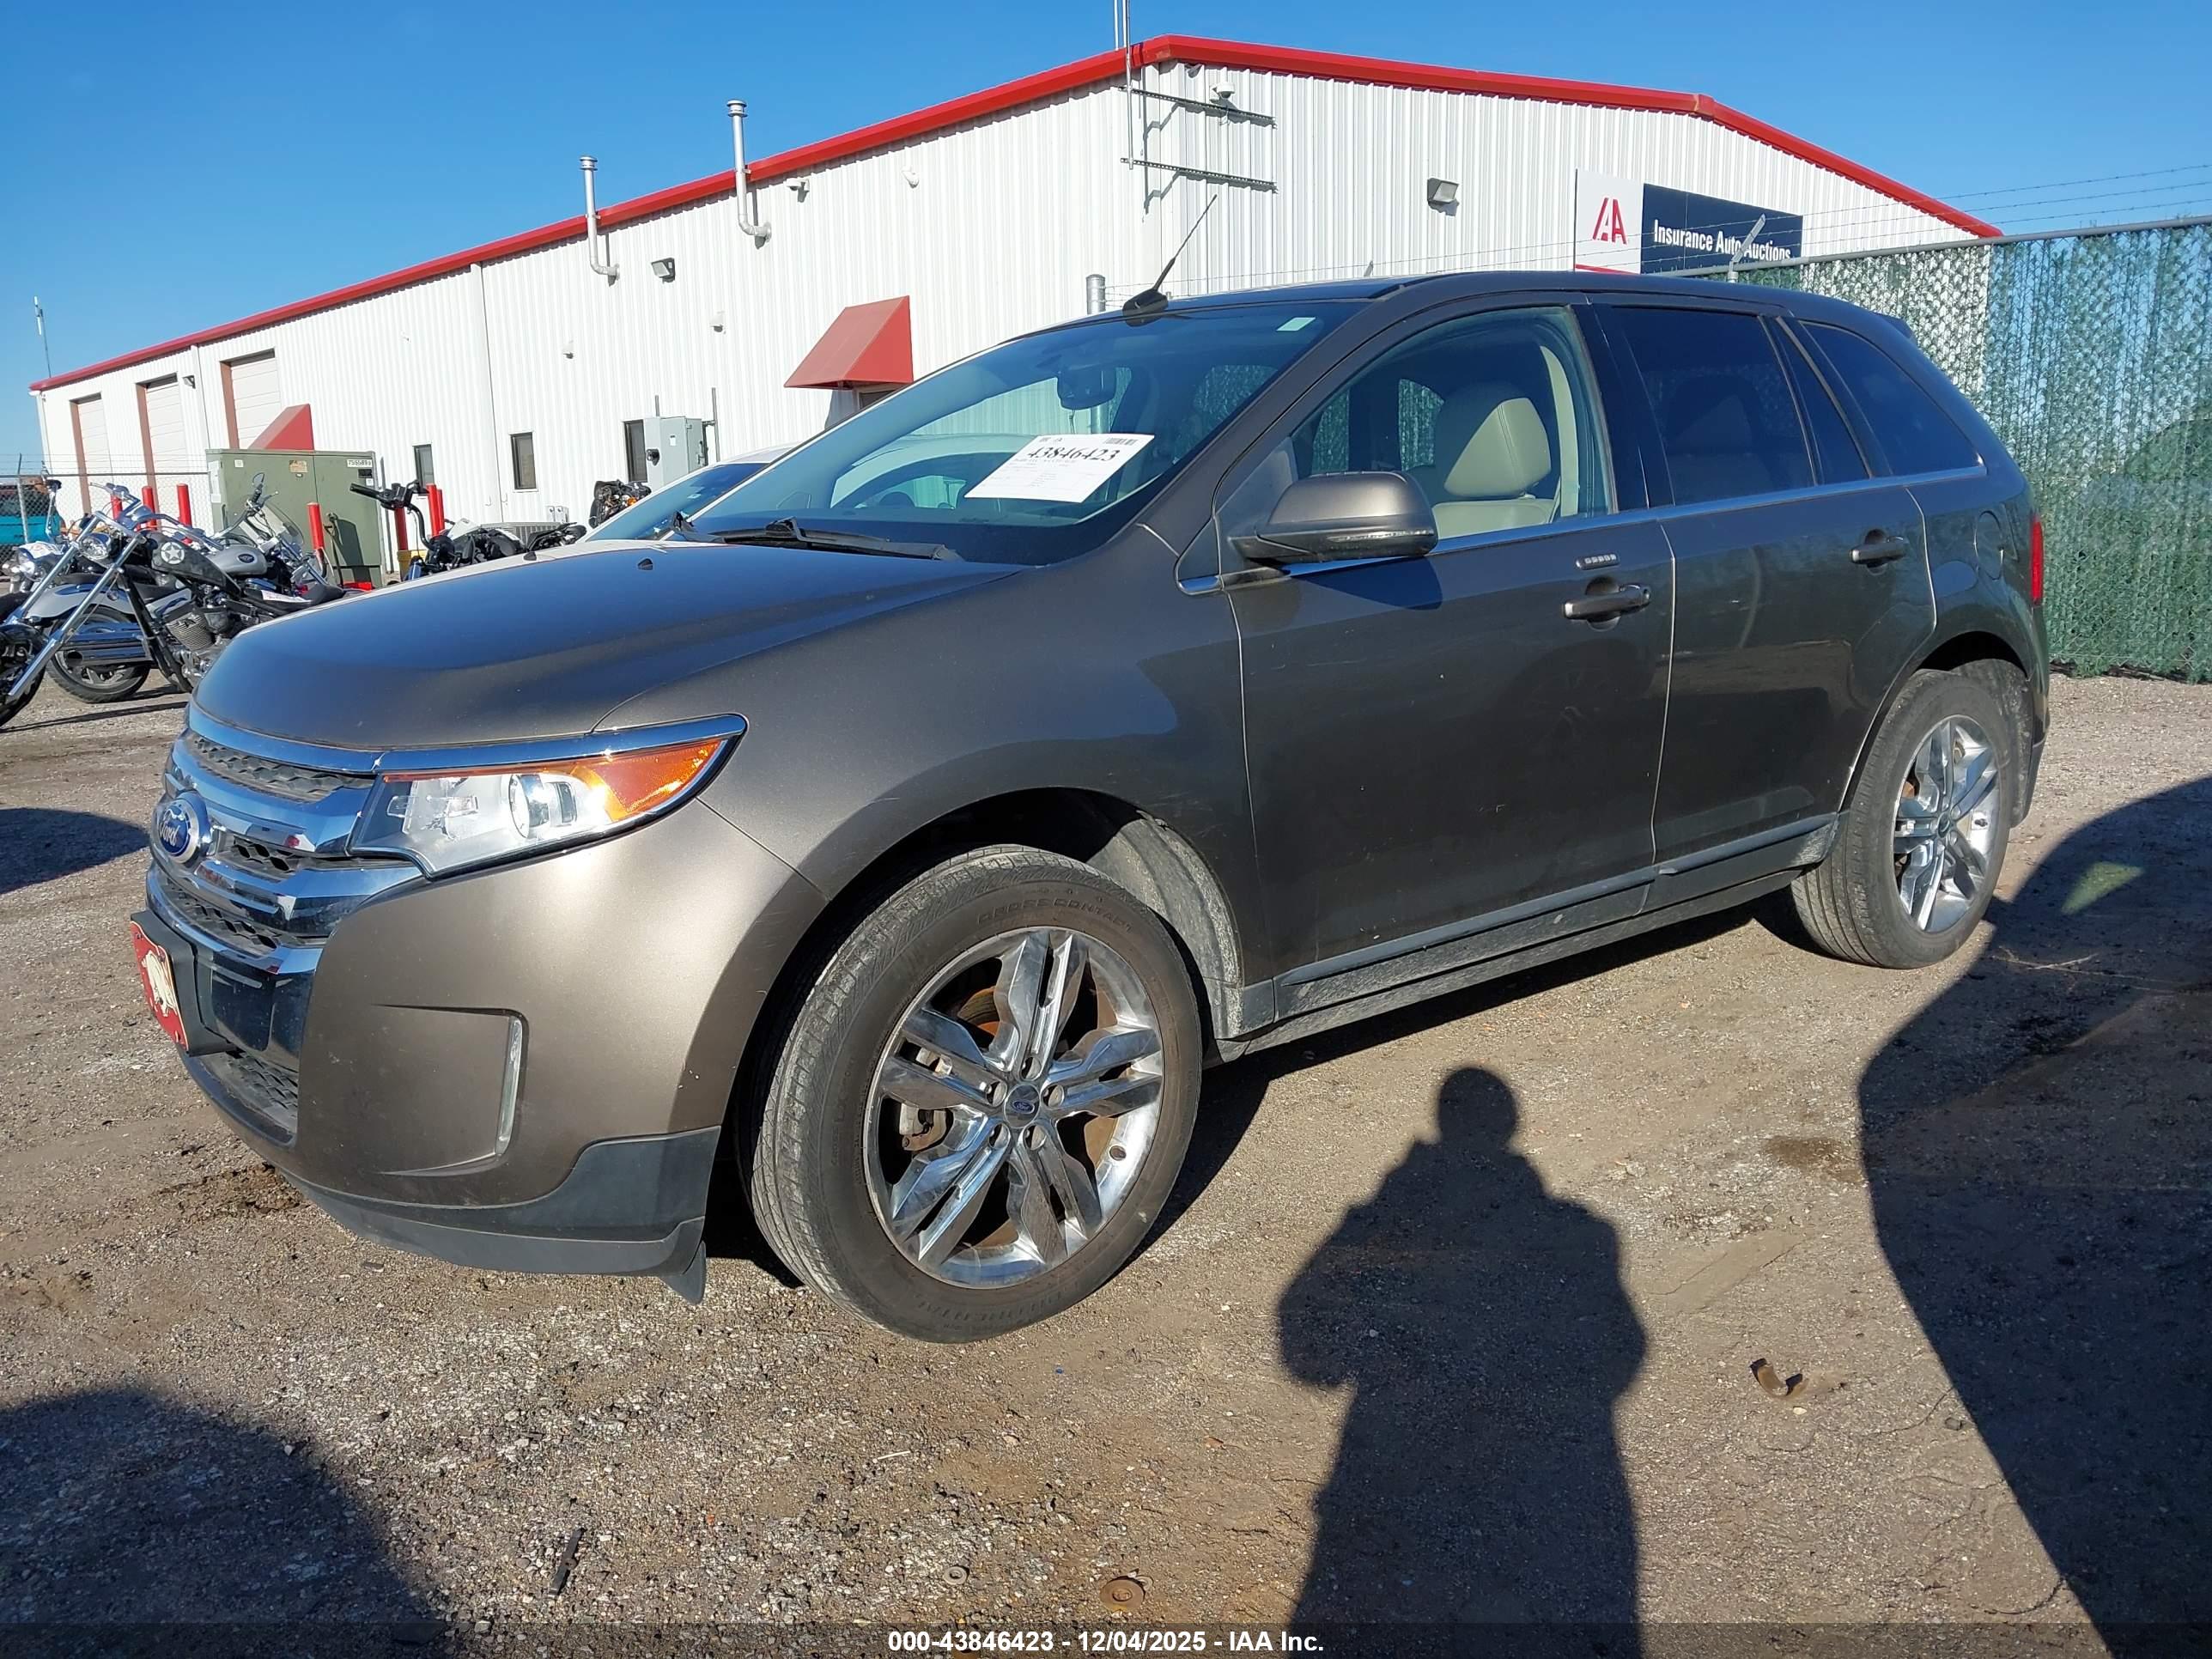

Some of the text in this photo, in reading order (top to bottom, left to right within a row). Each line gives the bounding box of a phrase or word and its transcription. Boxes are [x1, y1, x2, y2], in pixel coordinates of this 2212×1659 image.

[1654, 219, 1713, 252] Insurance
[1716, 230, 1741, 256] Auto
[1027, 446, 1120, 462] 43846423
